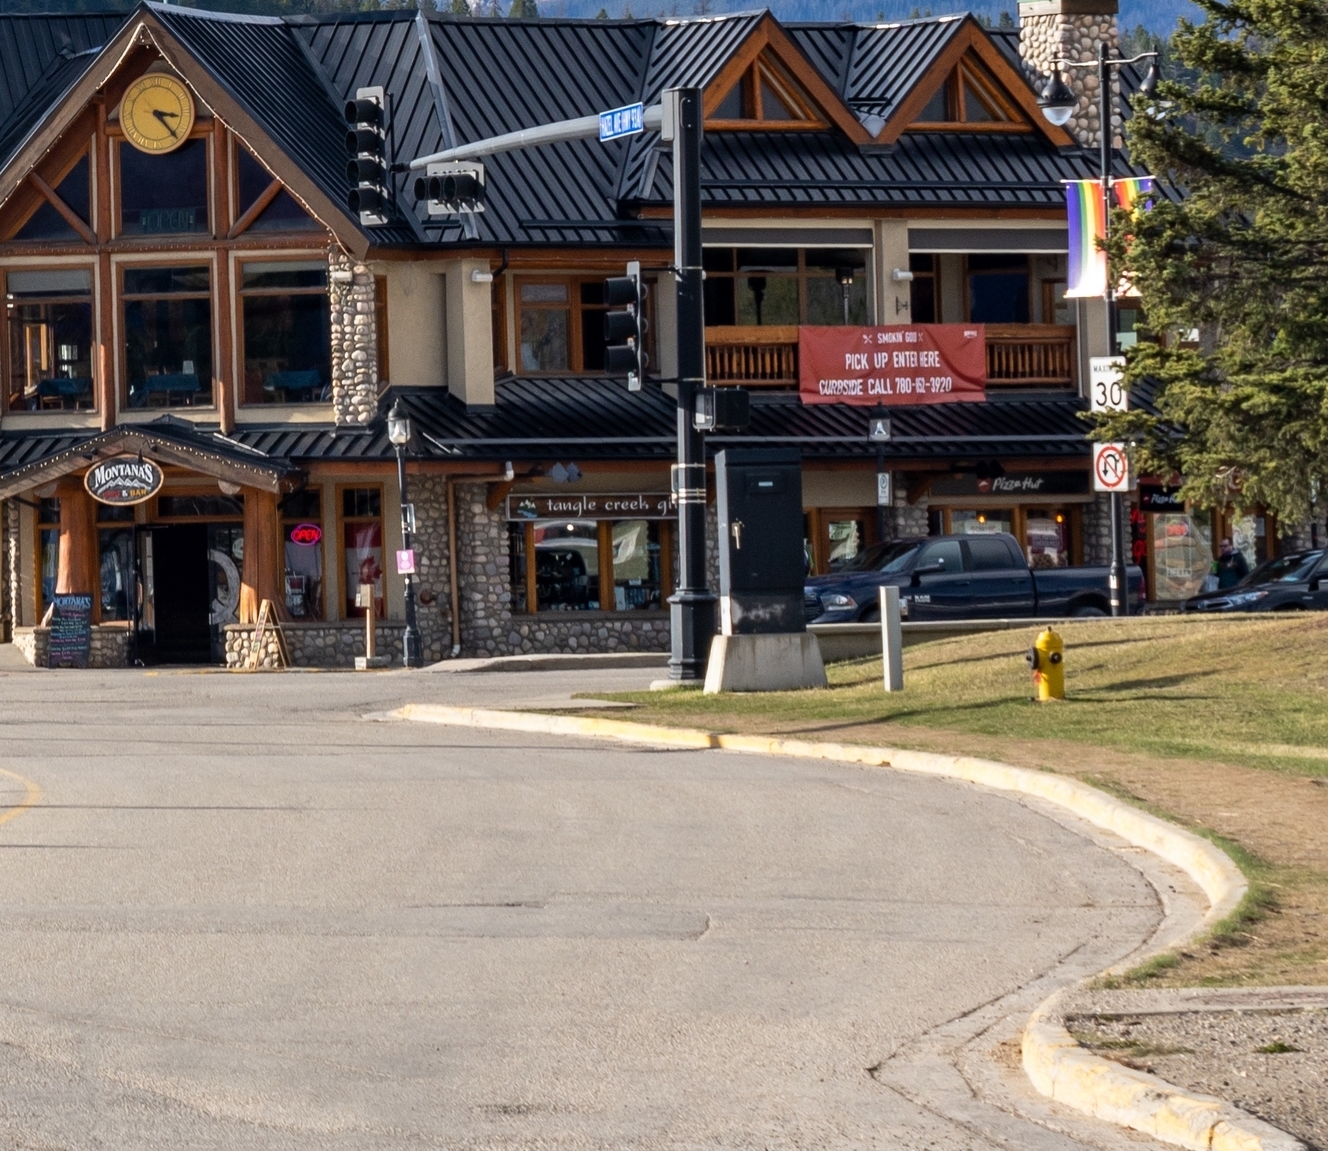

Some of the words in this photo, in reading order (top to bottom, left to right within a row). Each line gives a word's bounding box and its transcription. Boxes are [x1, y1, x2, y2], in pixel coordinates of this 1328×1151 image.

[845, 353, 869, 370] PICK
[874, 352, 889, 369] UP
[893, 351, 918, 368] ENTER
[919, 350, 941, 367] HERE
[818, 379, 863, 396] CURBSIDE
[868, 378, 893, 395] CALL
[1096, 381, 1122, 406] 30
[94, 463, 153, 489] MONTANA'S
[993, 476, 1021, 491] Pizza
[1022, 476, 1044, 490] Hut
[546, 495, 596, 518] tangle
[604, 495, 649, 511] creek
[293, 529, 319, 541] OPEN
